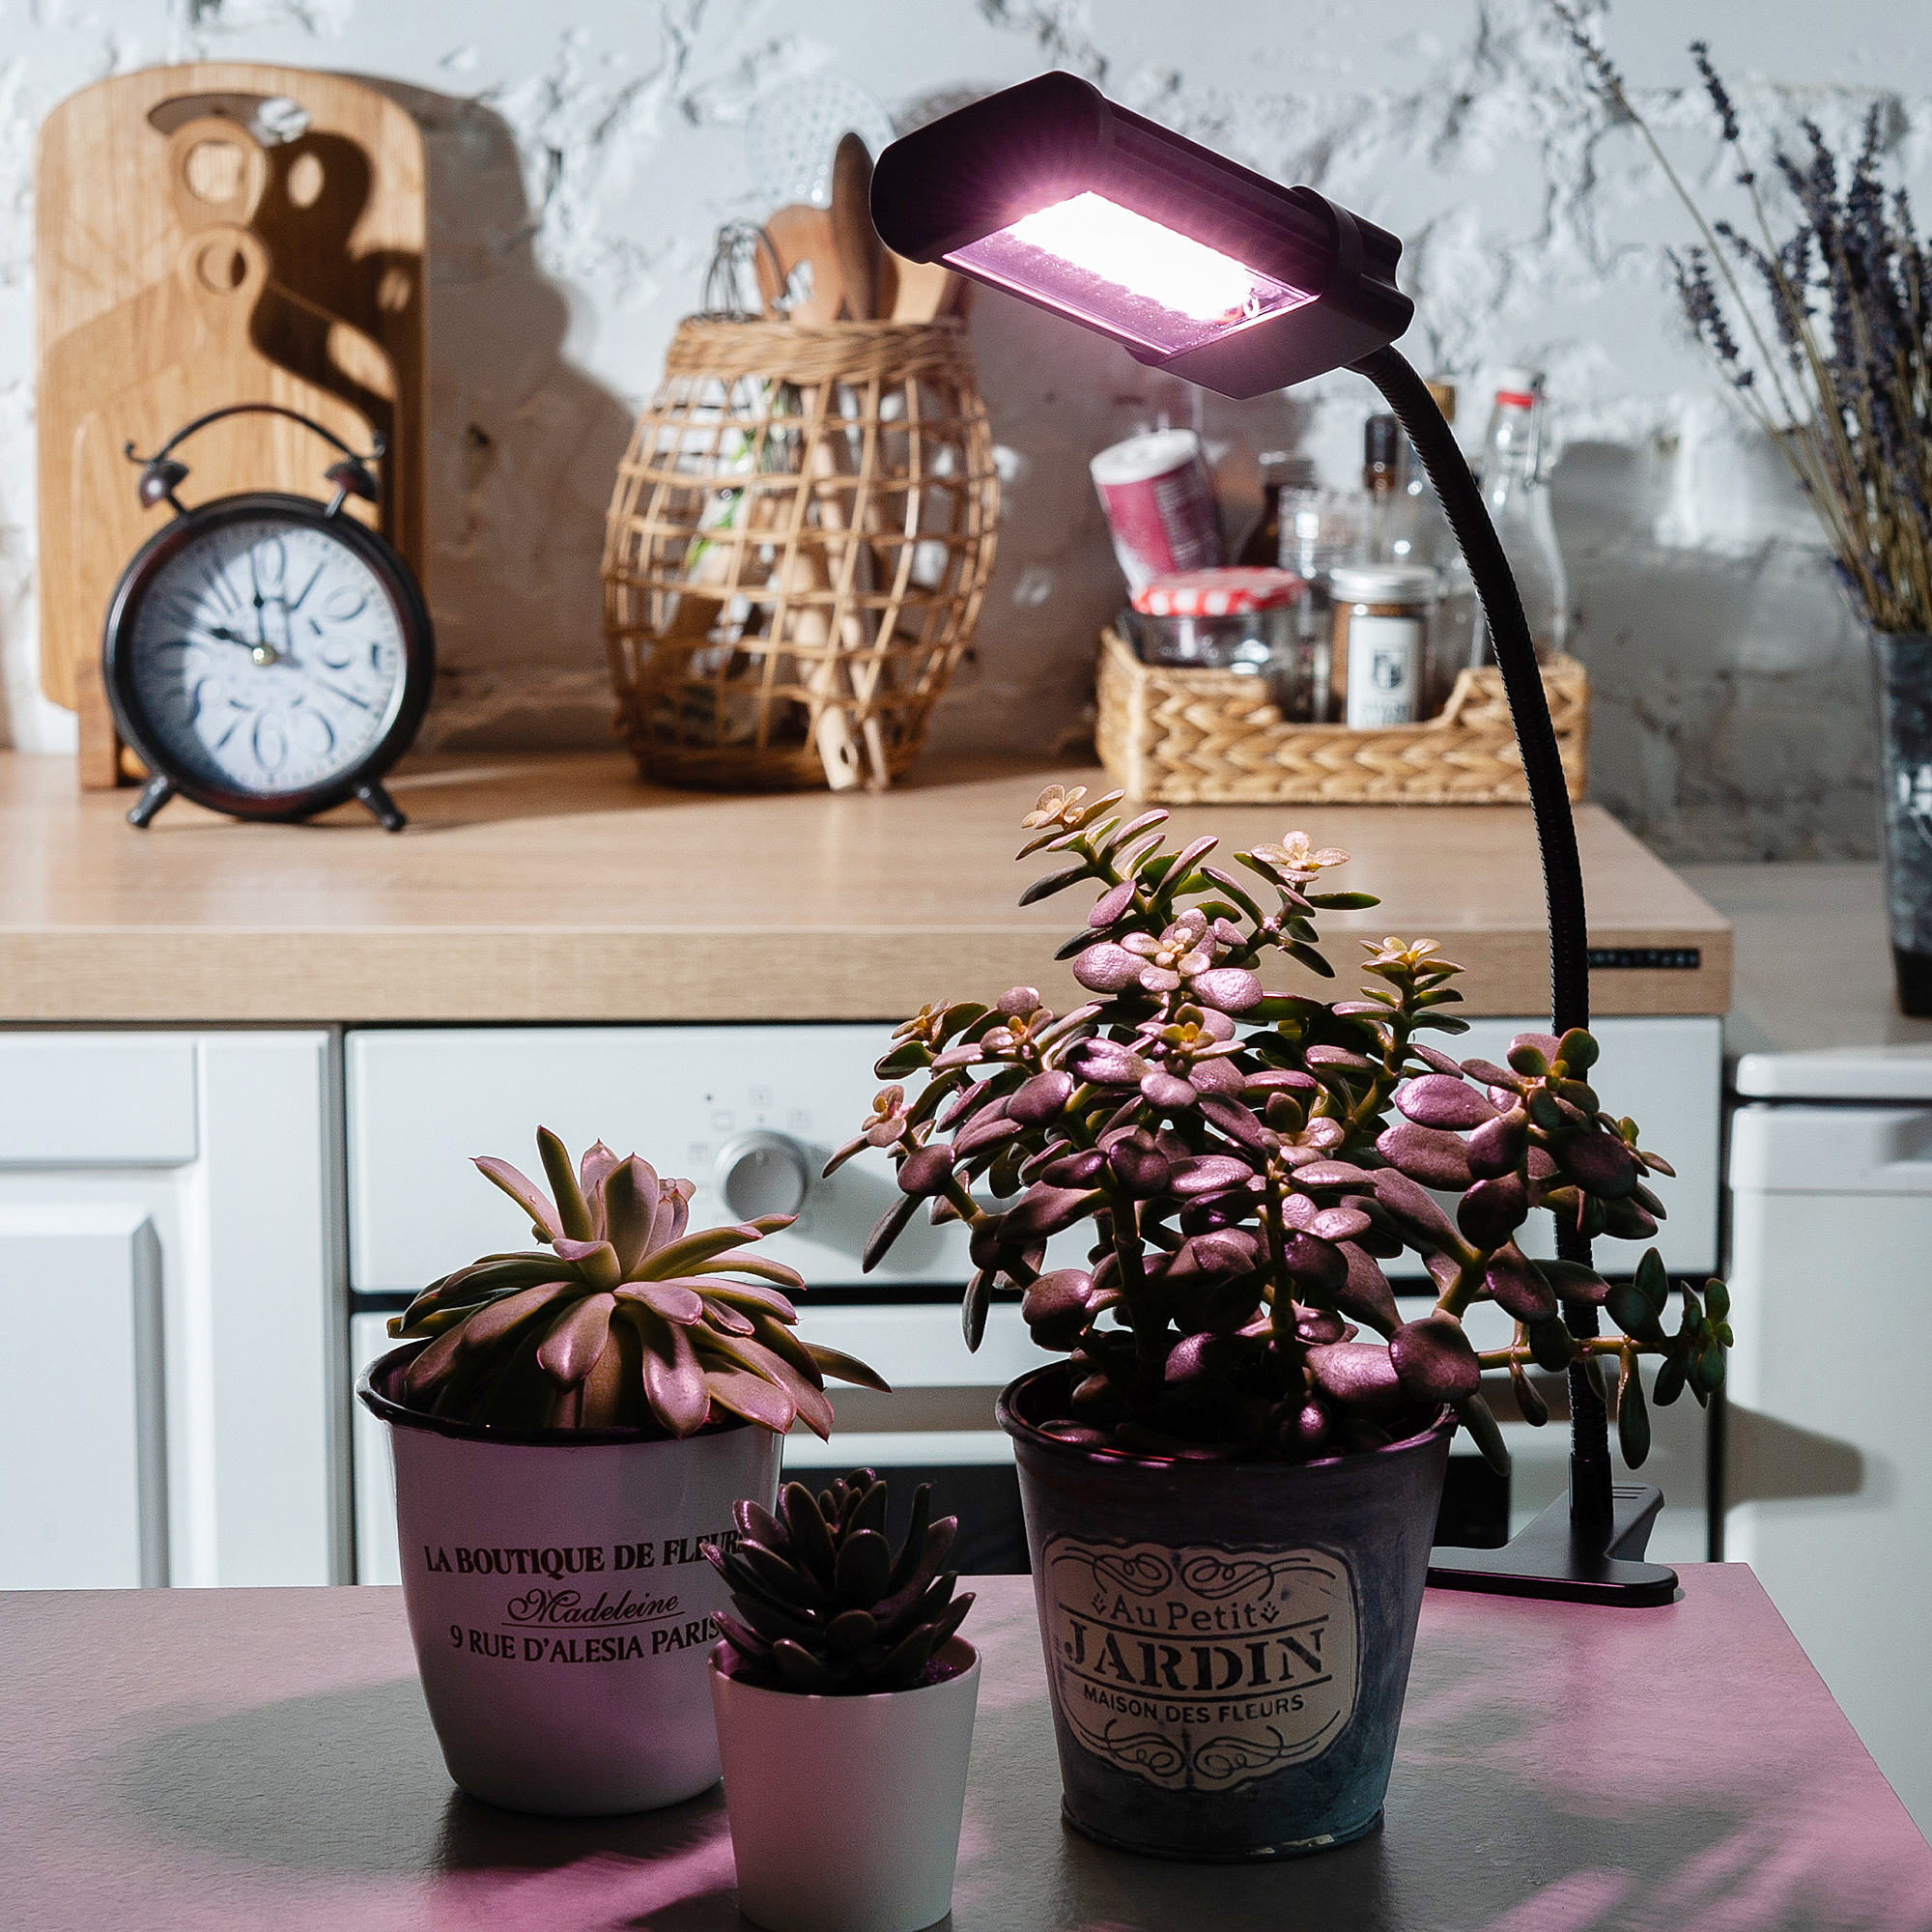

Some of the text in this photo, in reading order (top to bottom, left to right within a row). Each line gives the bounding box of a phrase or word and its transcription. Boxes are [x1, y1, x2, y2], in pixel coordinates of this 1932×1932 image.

[423, 1529, 743, 1581] LA BOUTIQUE DE FLEUR
[507, 1588, 679, 1624] Madeleine
[1111, 1596, 1258, 1632] Au Petit
[449, 1617, 720, 1663] 9 RUE D'ALESIA PARIS
[1064, 1618, 1325, 1690] JARDIN
[1084, 1683, 1304, 1724] MAISON DES FLEURS
